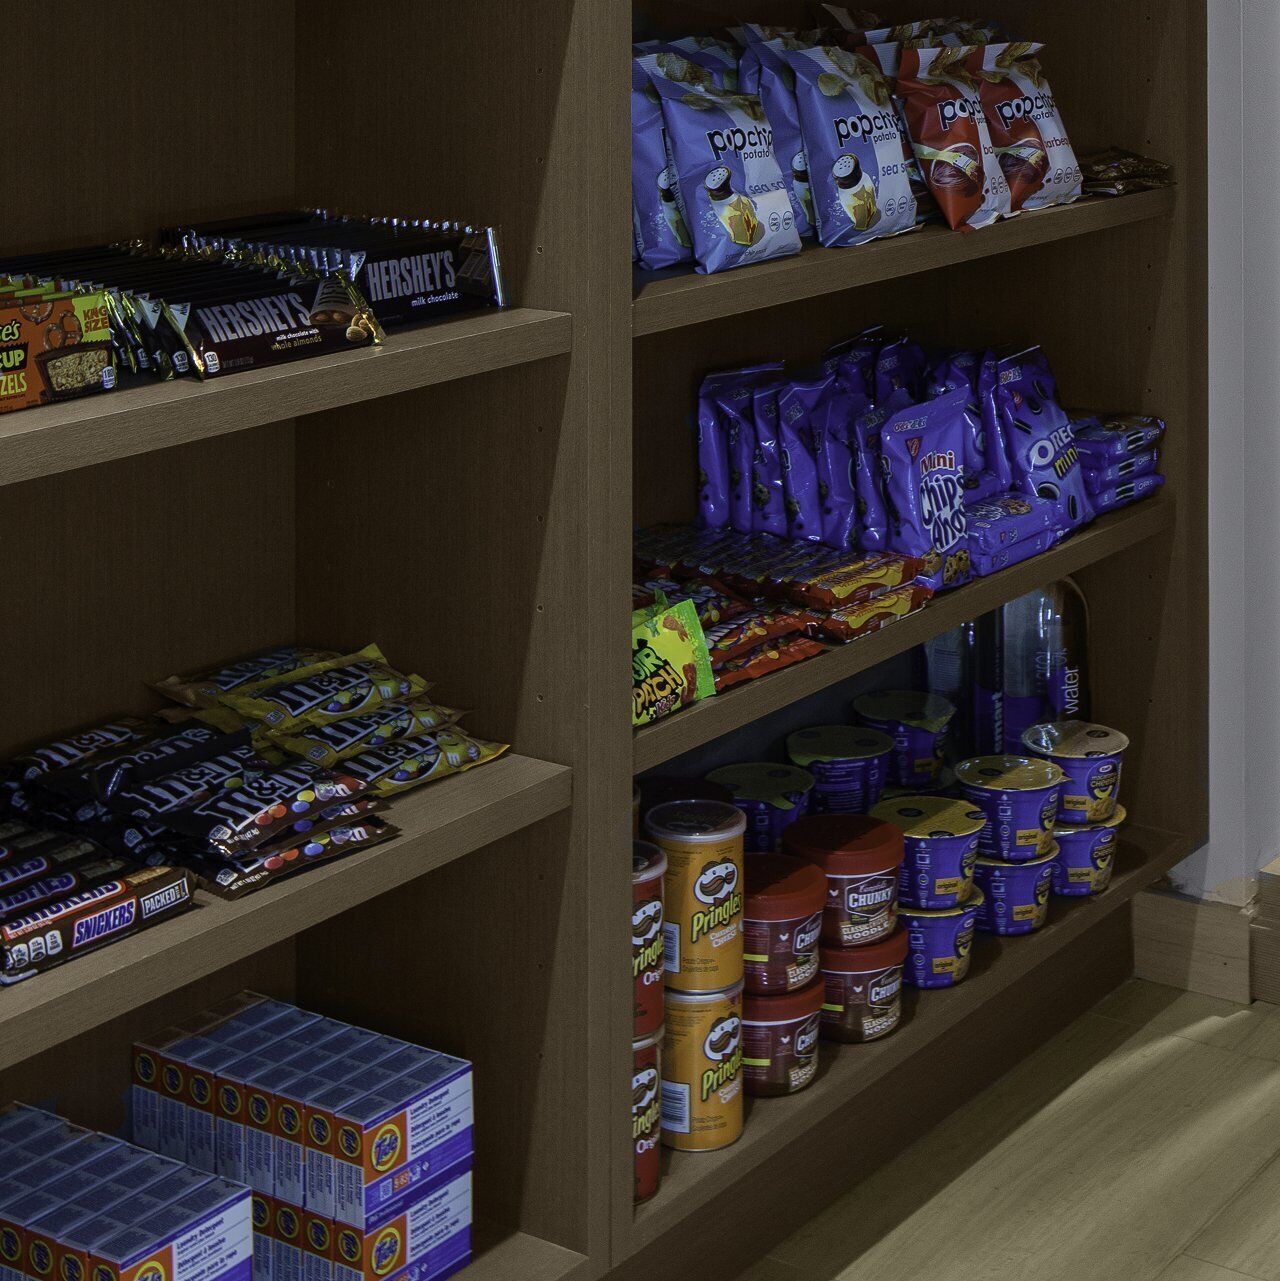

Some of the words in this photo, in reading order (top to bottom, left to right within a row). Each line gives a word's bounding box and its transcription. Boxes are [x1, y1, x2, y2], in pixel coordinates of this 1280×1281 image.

[872, 130, 898, 145] potato
[742, 148, 771, 162] potato
[880, 161, 900, 177] sea
[748, 180, 770, 196] sea
[366, 250, 457, 302] HERSHEY'S
[411, 296, 425, 307] milk
[426, 291, 459, 305] chocolate
[195, 292, 313, 345] HERSHEY'S
[84, 320, 110, 335] SIZE
[275, 332, 289, 342] milk
[289, 328, 308, 340] chocolate
[308, 327, 320, 336] with
[271, 338, 291, 351] whole
[292, 334, 323, 349] almonds
[921, 450, 954, 473] Mini
[632, 663, 684, 719] PATCH
[1060, 664, 1080, 716] water
[1065, 797, 1087, 809] original
[1018, 832, 1039, 842] original
[936, 880, 958, 892] original
[848, 886, 894, 908] CHUNKY
[74, 900, 136, 946] SNICKERS
[144, 891, 176, 913] PACKED
[690, 892, 742, 943] Pringles
